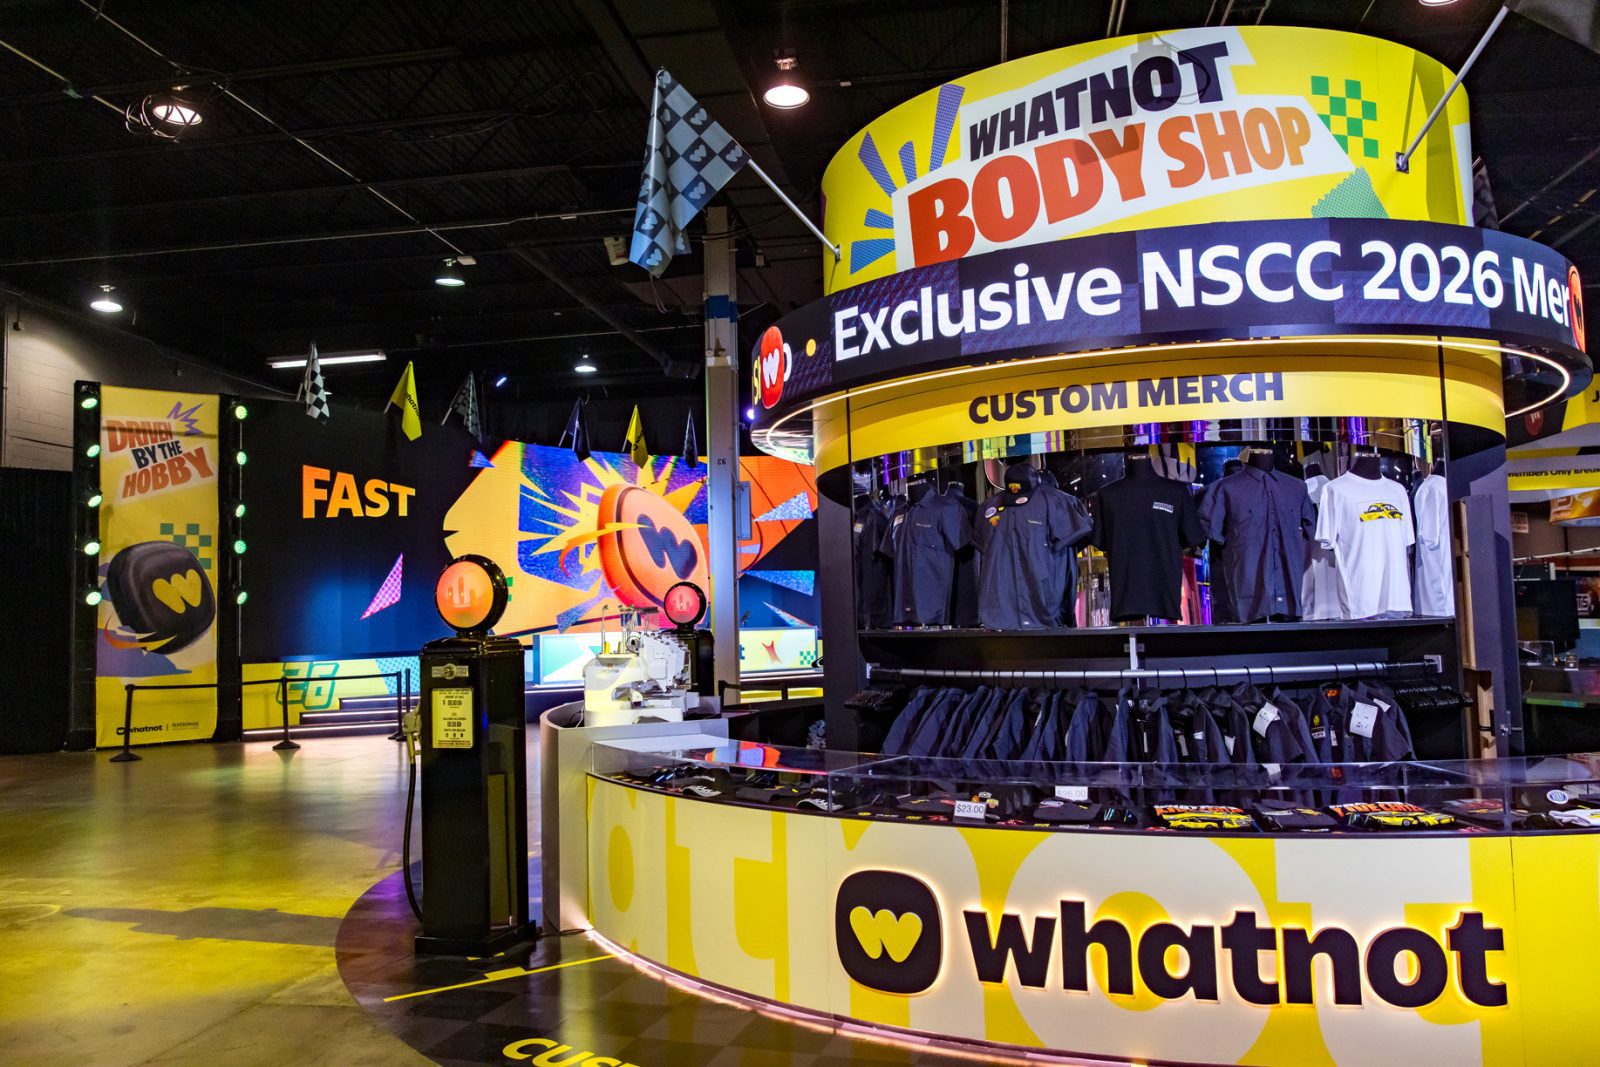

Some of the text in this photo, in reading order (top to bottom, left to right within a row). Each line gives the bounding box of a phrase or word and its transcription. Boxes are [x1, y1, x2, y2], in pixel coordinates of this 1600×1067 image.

[970, 42, 1230, 161] WHATNOT
[907, 106, 1312, 267] BODY SHOP
[834, 262, 1122, 362] Exclusive
[1142, 241, 1345, 311] NSCC
[1363, 240, 1504, 310] 2026
[968, 372, 1284, 425] CUSTOM MERCH
[106, 420, 174, 453] DRIVEN
[131, 440, 183, 470] BY THE
[122, 446, 214, 499] HOBBY
[302, 464, 416, 519] FAST
[957, 804, 984, 815] $23.00
[963, 899, 1509, 1009] whatnot
